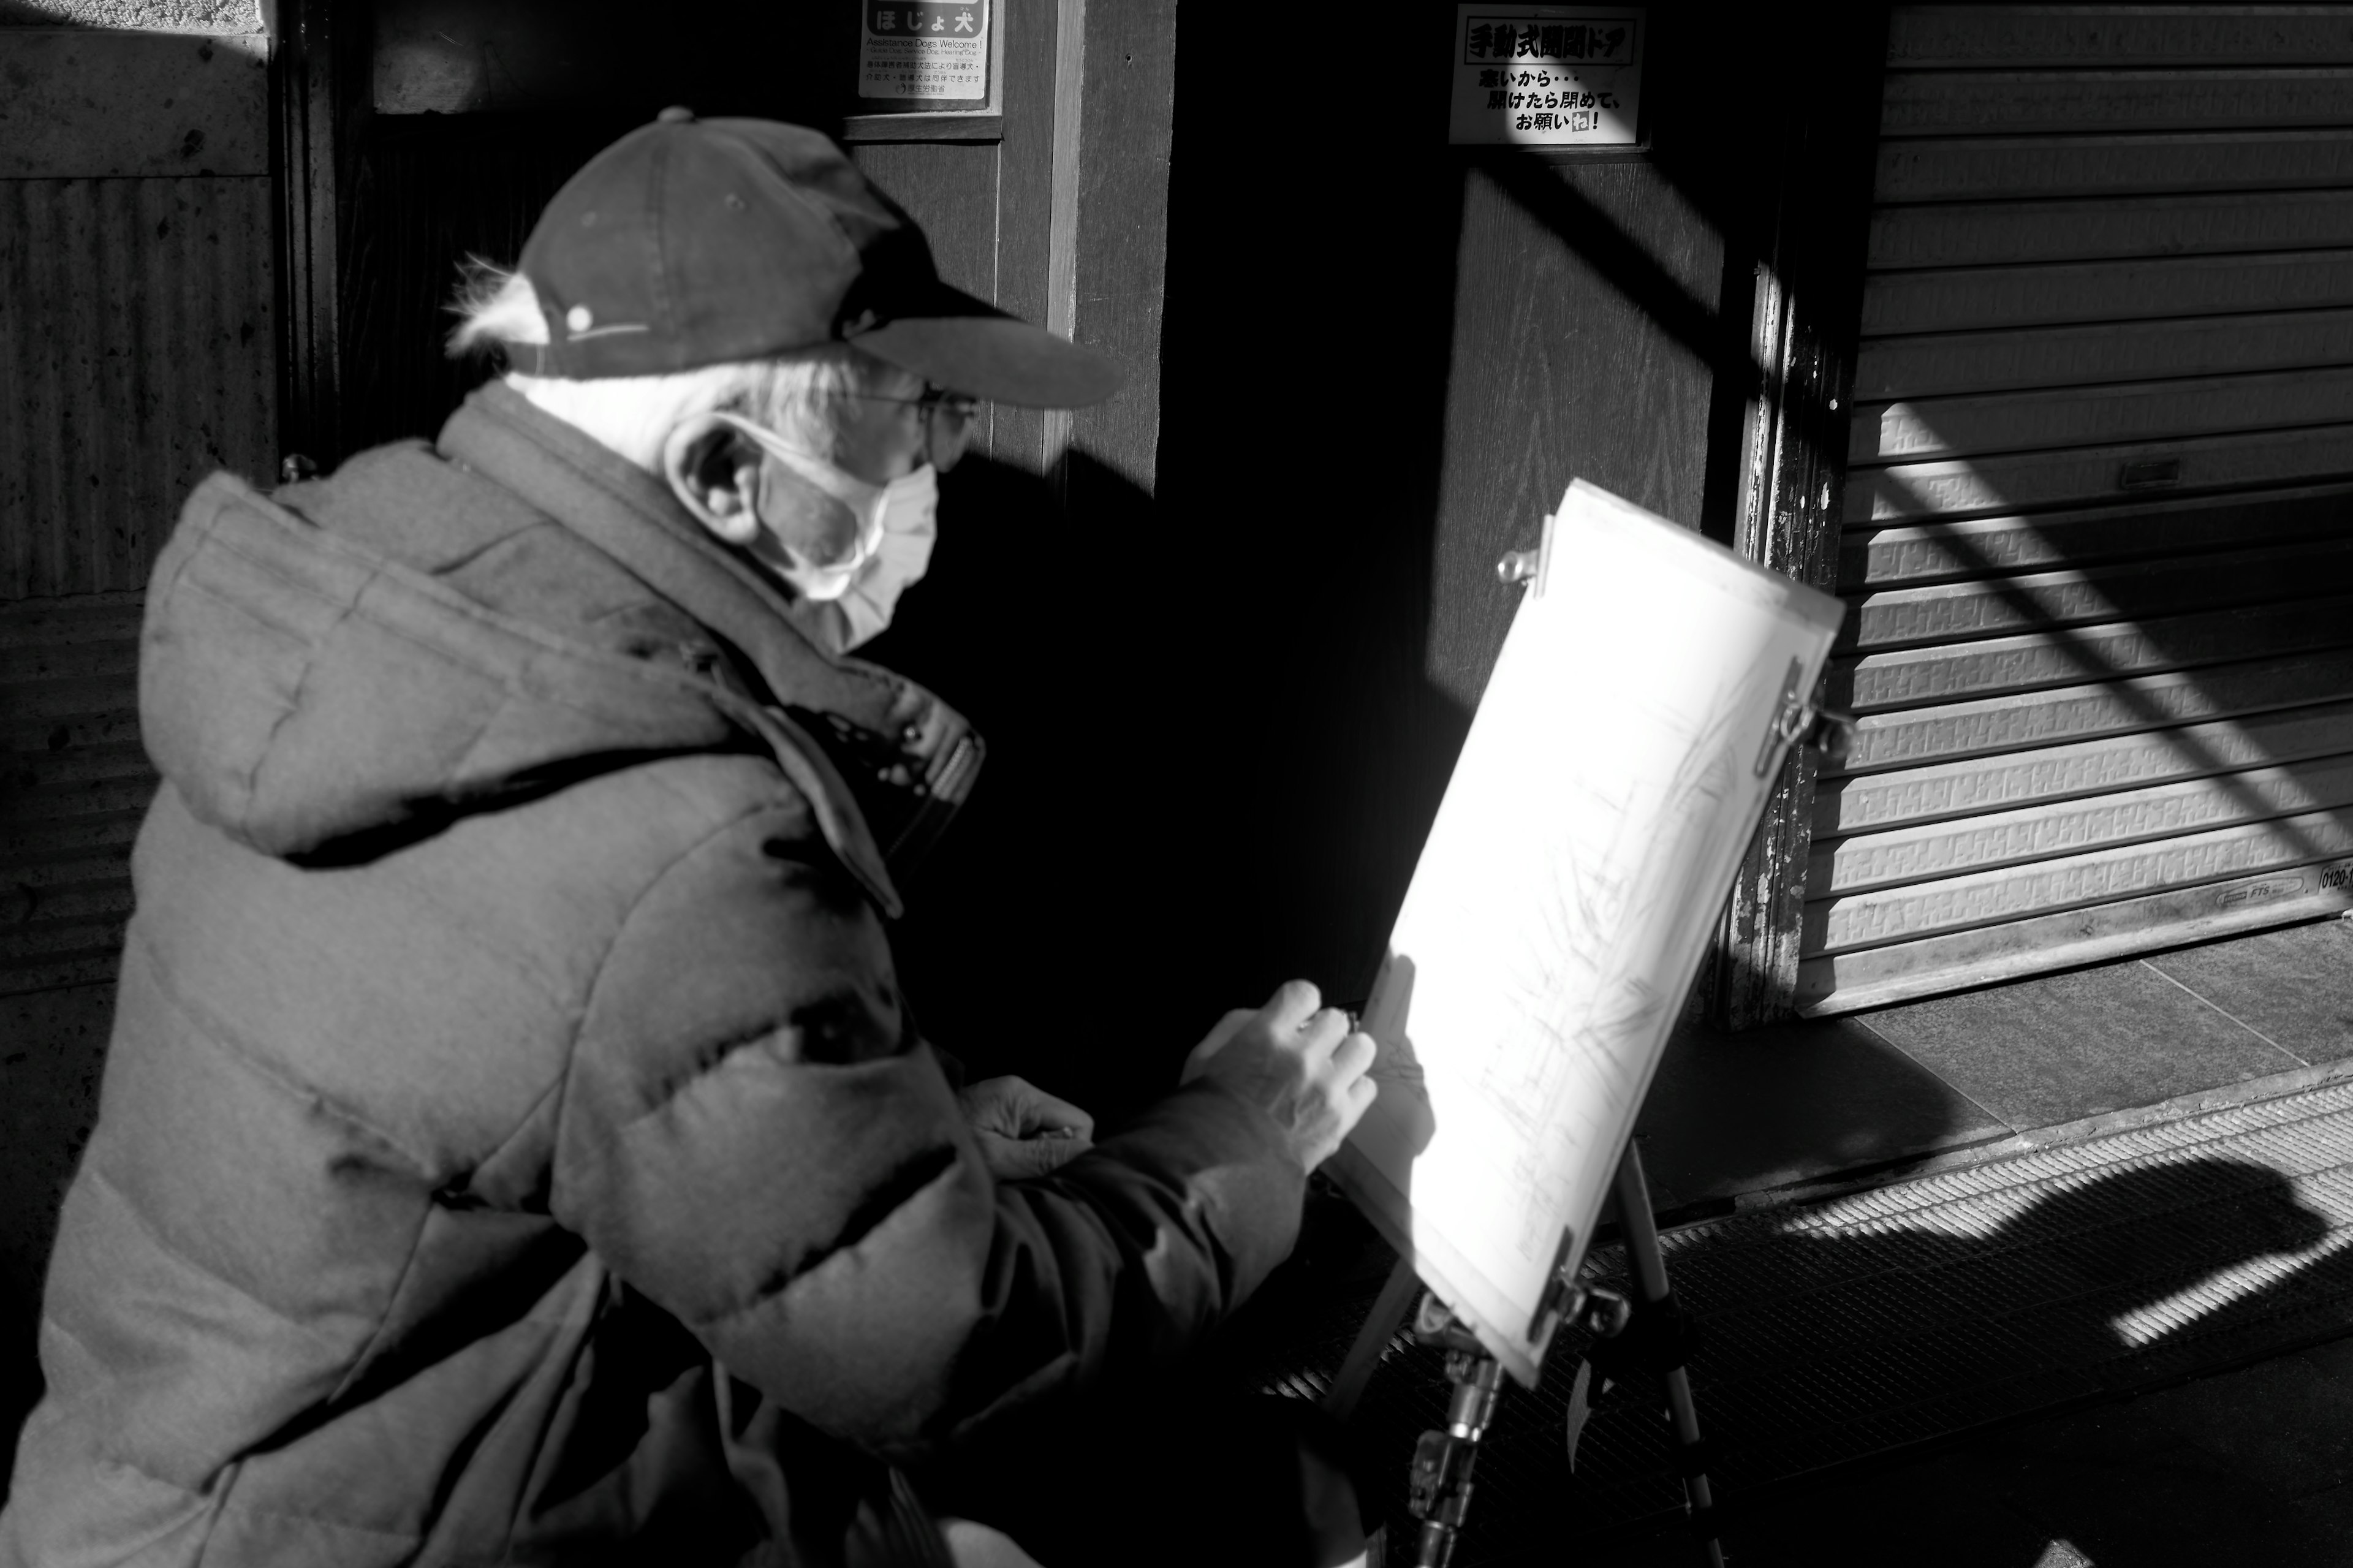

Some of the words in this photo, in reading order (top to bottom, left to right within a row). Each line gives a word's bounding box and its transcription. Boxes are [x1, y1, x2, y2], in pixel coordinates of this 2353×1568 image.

[876, 10, 974, 32] ほじょ犬
[866, 37, 913, 47] Assistance
[915, 39, 937, 49] Dogs
[939, 40, 977, 49] Welcome
